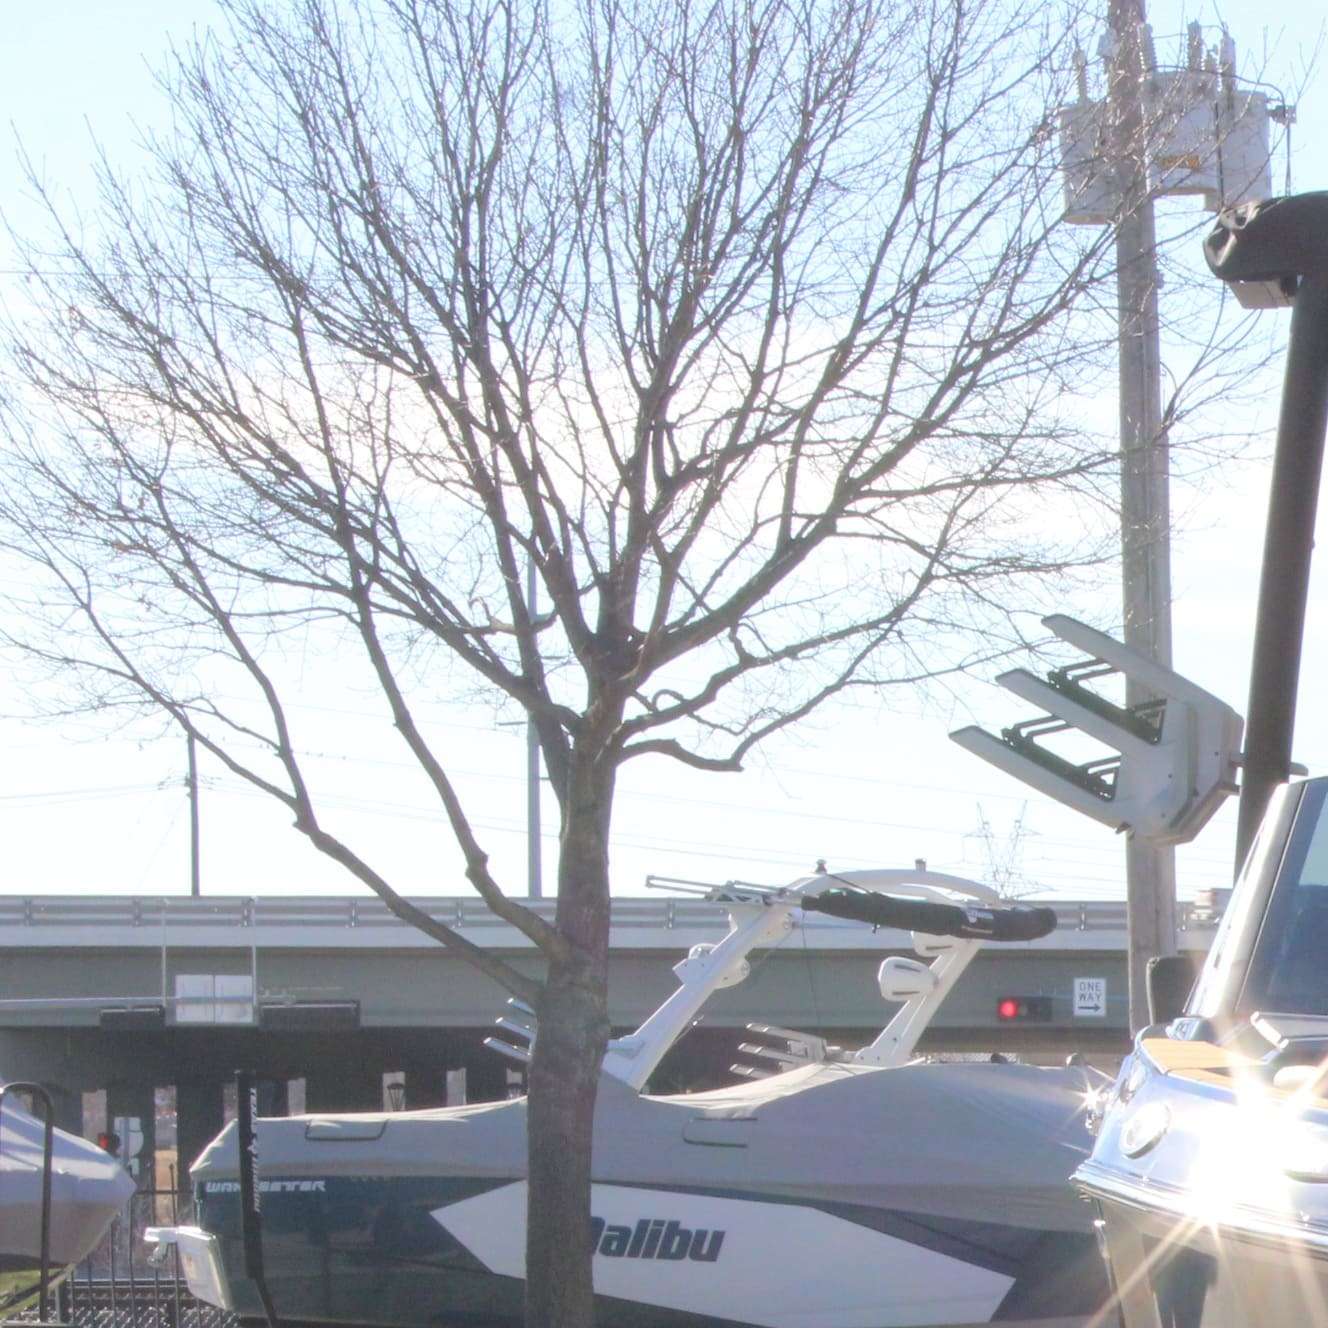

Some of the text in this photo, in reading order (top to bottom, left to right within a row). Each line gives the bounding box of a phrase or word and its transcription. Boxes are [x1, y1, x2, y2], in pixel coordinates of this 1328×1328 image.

[1079, 982, 1102, 992] ONE
[1078, 994, 1102, 1003] WAY
[591, 1216, 726, 1263] alibu
